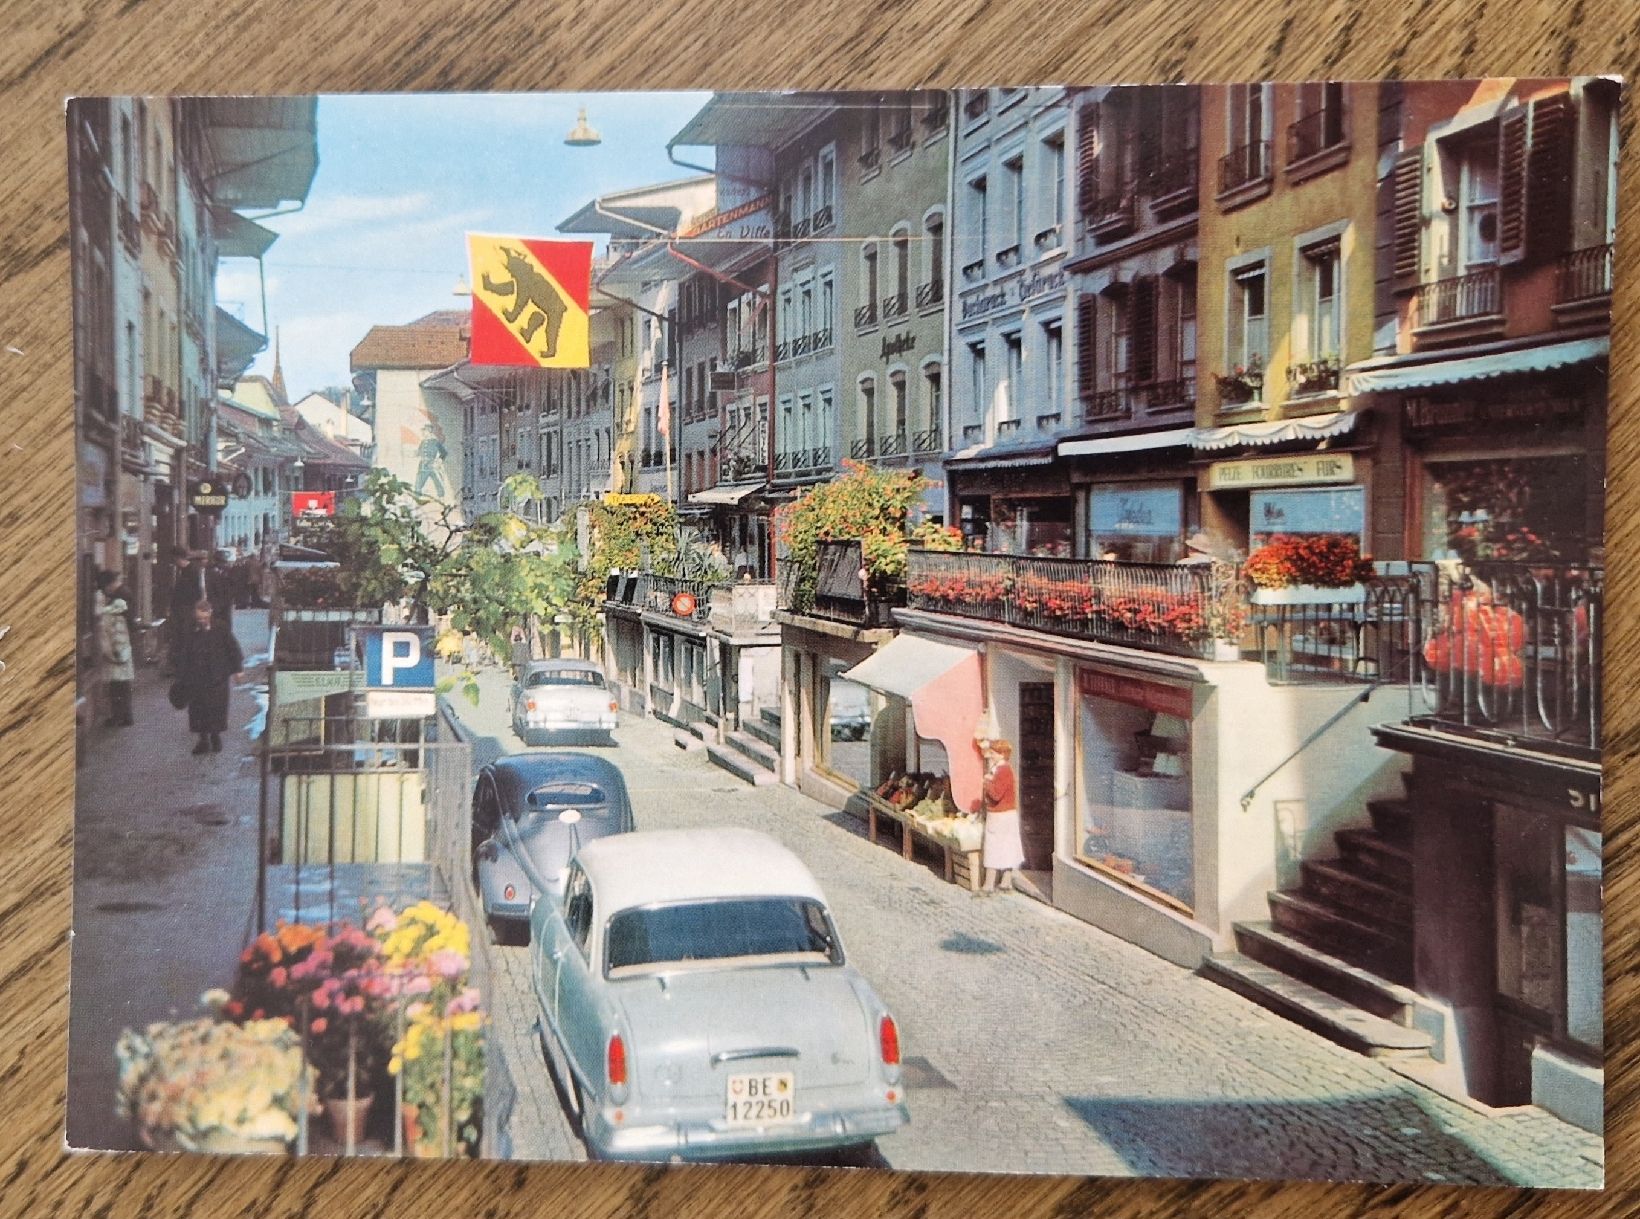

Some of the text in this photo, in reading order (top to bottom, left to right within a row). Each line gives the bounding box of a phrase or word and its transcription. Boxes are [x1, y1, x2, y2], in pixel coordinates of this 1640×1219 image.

[381, 632, 421, 685] P
[748, 1077, 773, 1097] BE
[731, 1099, 790, 1121] 12250
